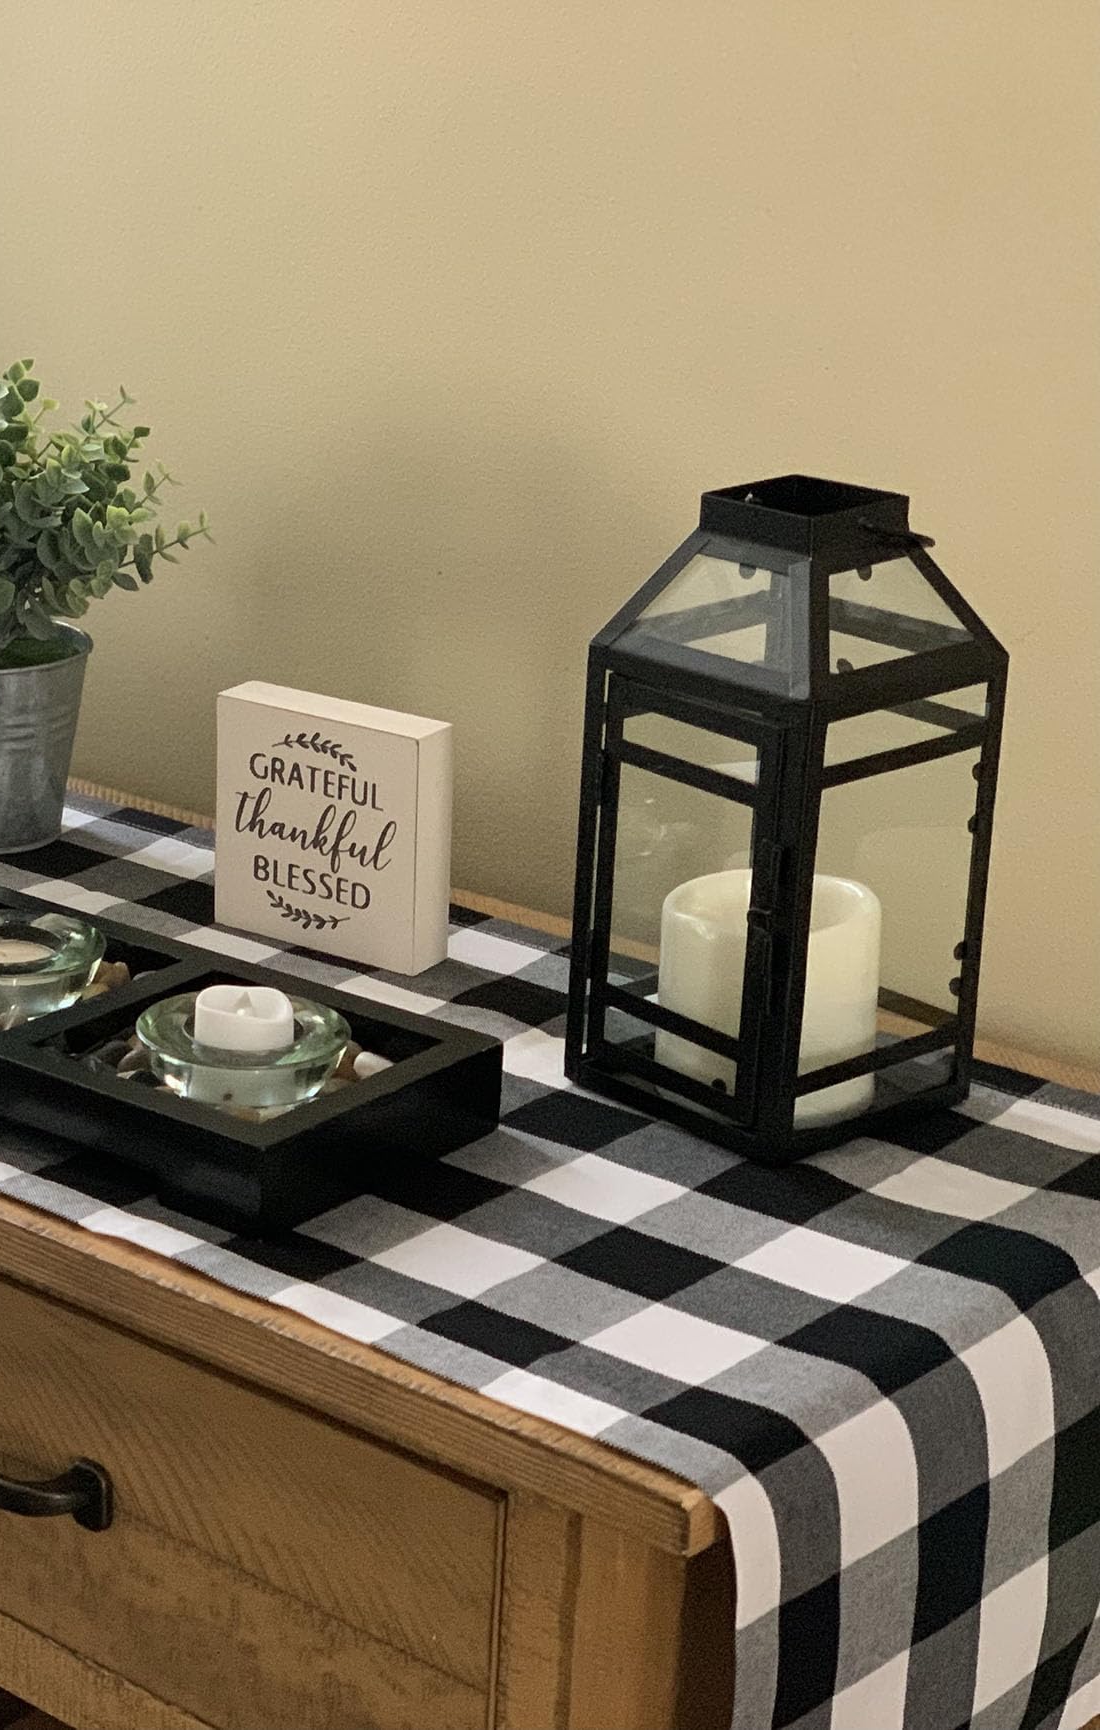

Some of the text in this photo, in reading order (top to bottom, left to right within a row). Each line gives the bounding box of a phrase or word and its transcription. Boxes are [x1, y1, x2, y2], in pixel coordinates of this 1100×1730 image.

[249, 753, 384, 811] GRATEFUL
[235, 787, 397, 873] thankful
[253, 855, 371, 910] BLESSED
